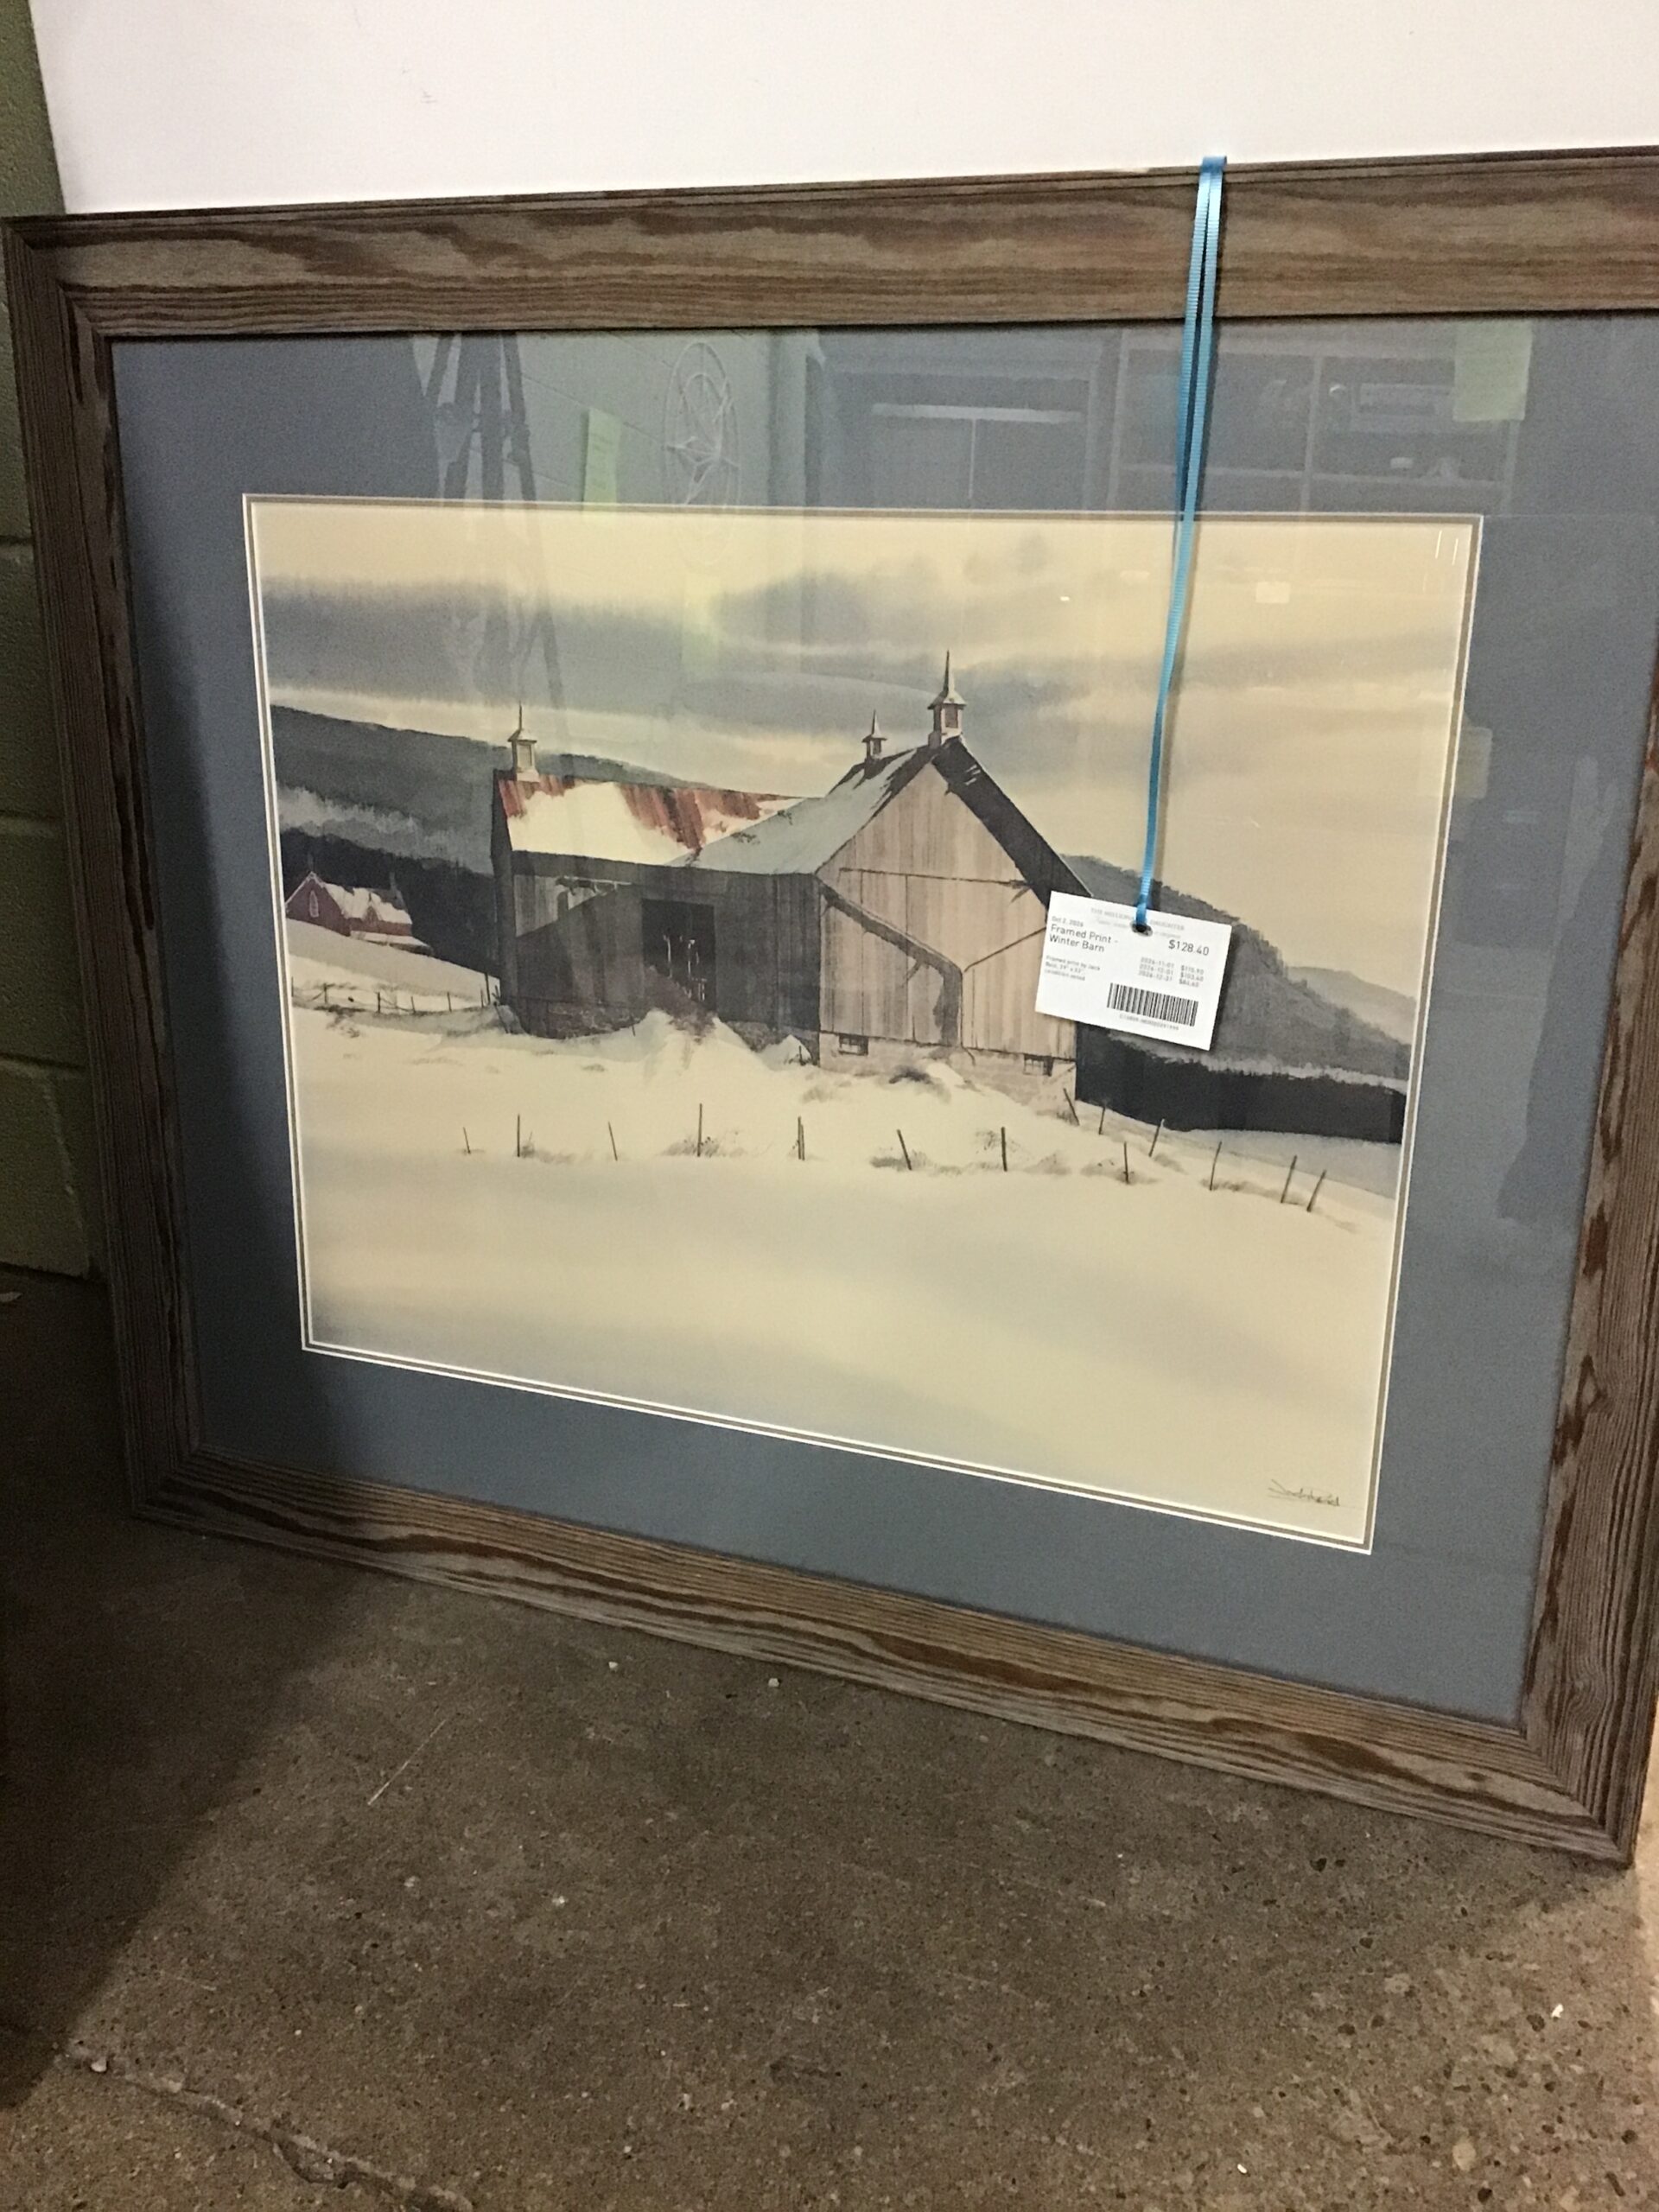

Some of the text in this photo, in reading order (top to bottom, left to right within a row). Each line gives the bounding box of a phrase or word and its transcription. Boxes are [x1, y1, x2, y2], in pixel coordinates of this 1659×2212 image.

[1049, 933, 1104, 952] Winter Barn
[1050, 923, 1086, 938] Framed
[1089, 931, 1111, 944] Print
[1167, 938, 1210, 957] $128.40
